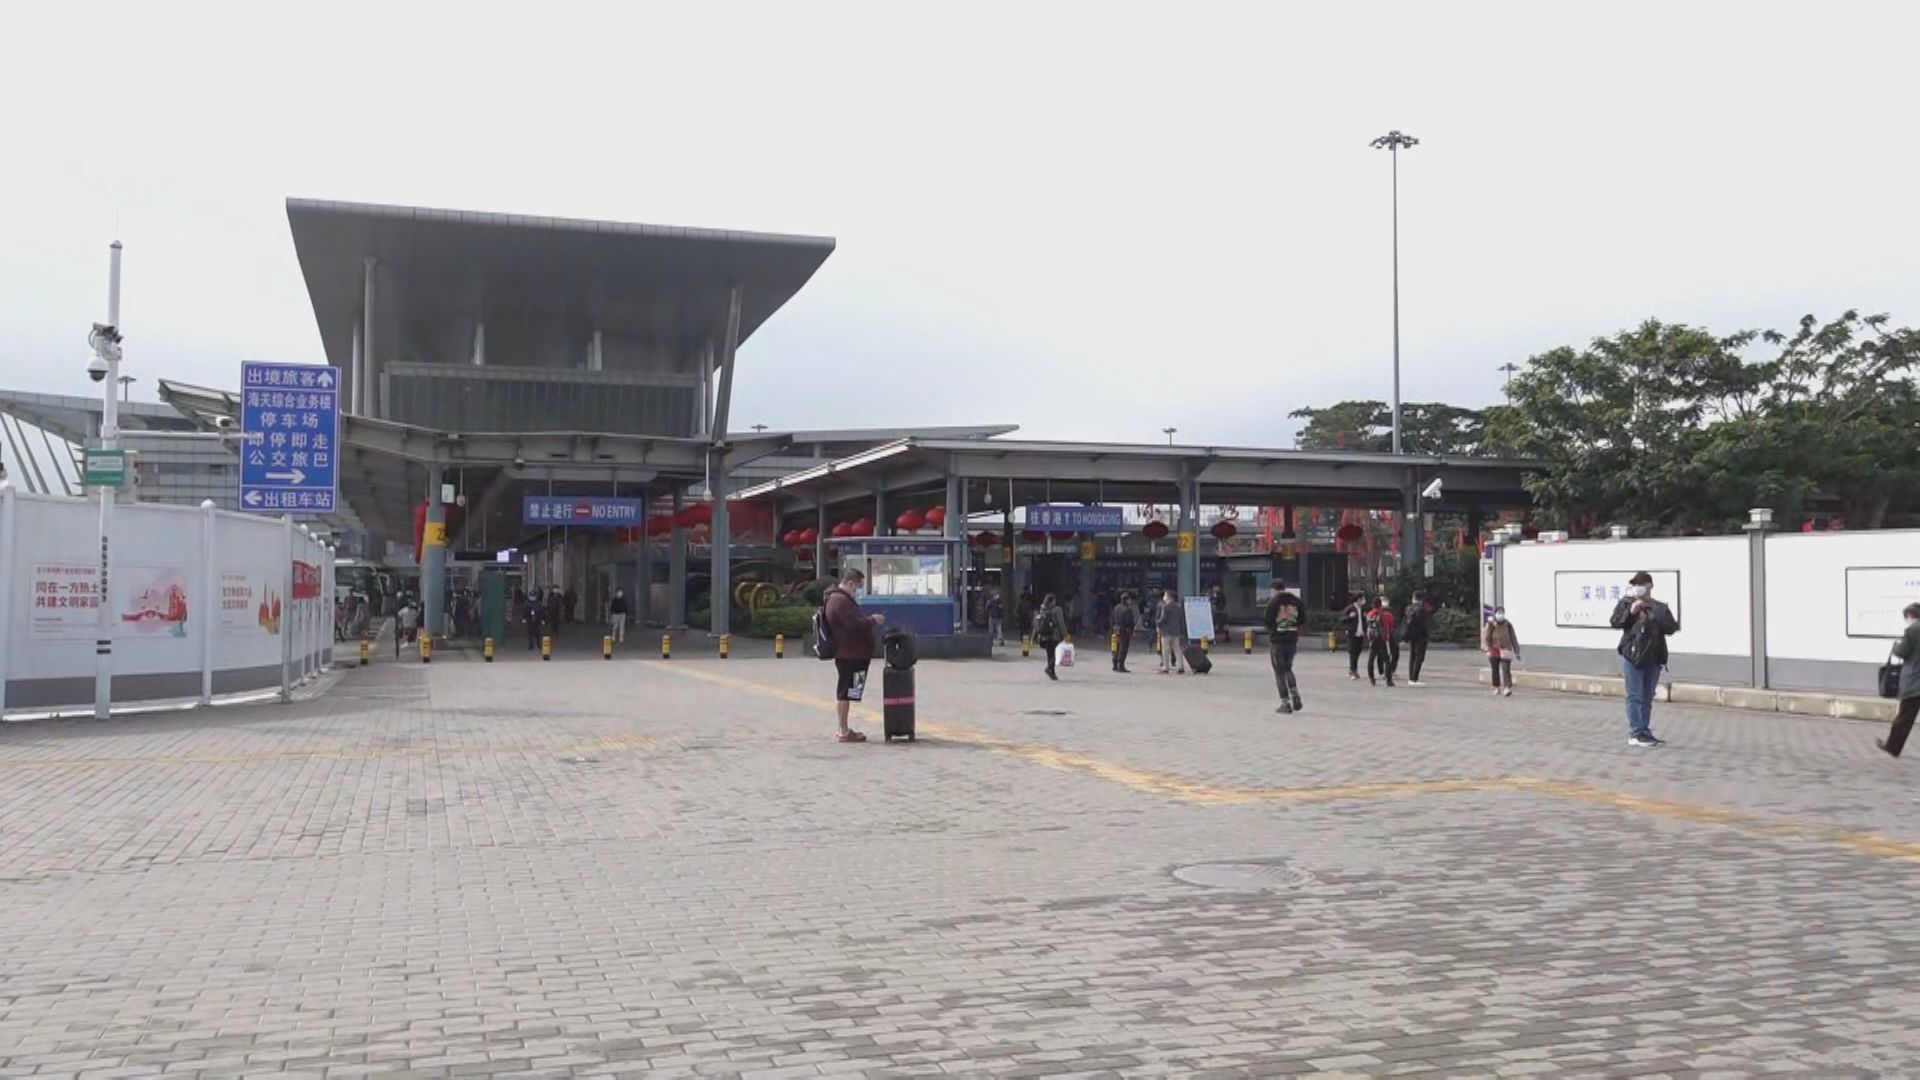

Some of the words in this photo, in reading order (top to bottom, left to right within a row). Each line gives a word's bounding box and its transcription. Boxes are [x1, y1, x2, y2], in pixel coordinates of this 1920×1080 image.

[247, 368, 316, 386] 出境旅客
[248, 392, 331, 409] 海关综合业务楼
[261, 412, 319, 428] 停车场
[248, 432, 329, 449] 即停即走
[249, 450, 328, 467] 公交旅巴
[264, 491, 331, 507] 出租车站
[530, 503, 573, 519] 禁止逆行
[591, 505, 606, 518] NO
[607, 505, 636, 518] ENTRY
